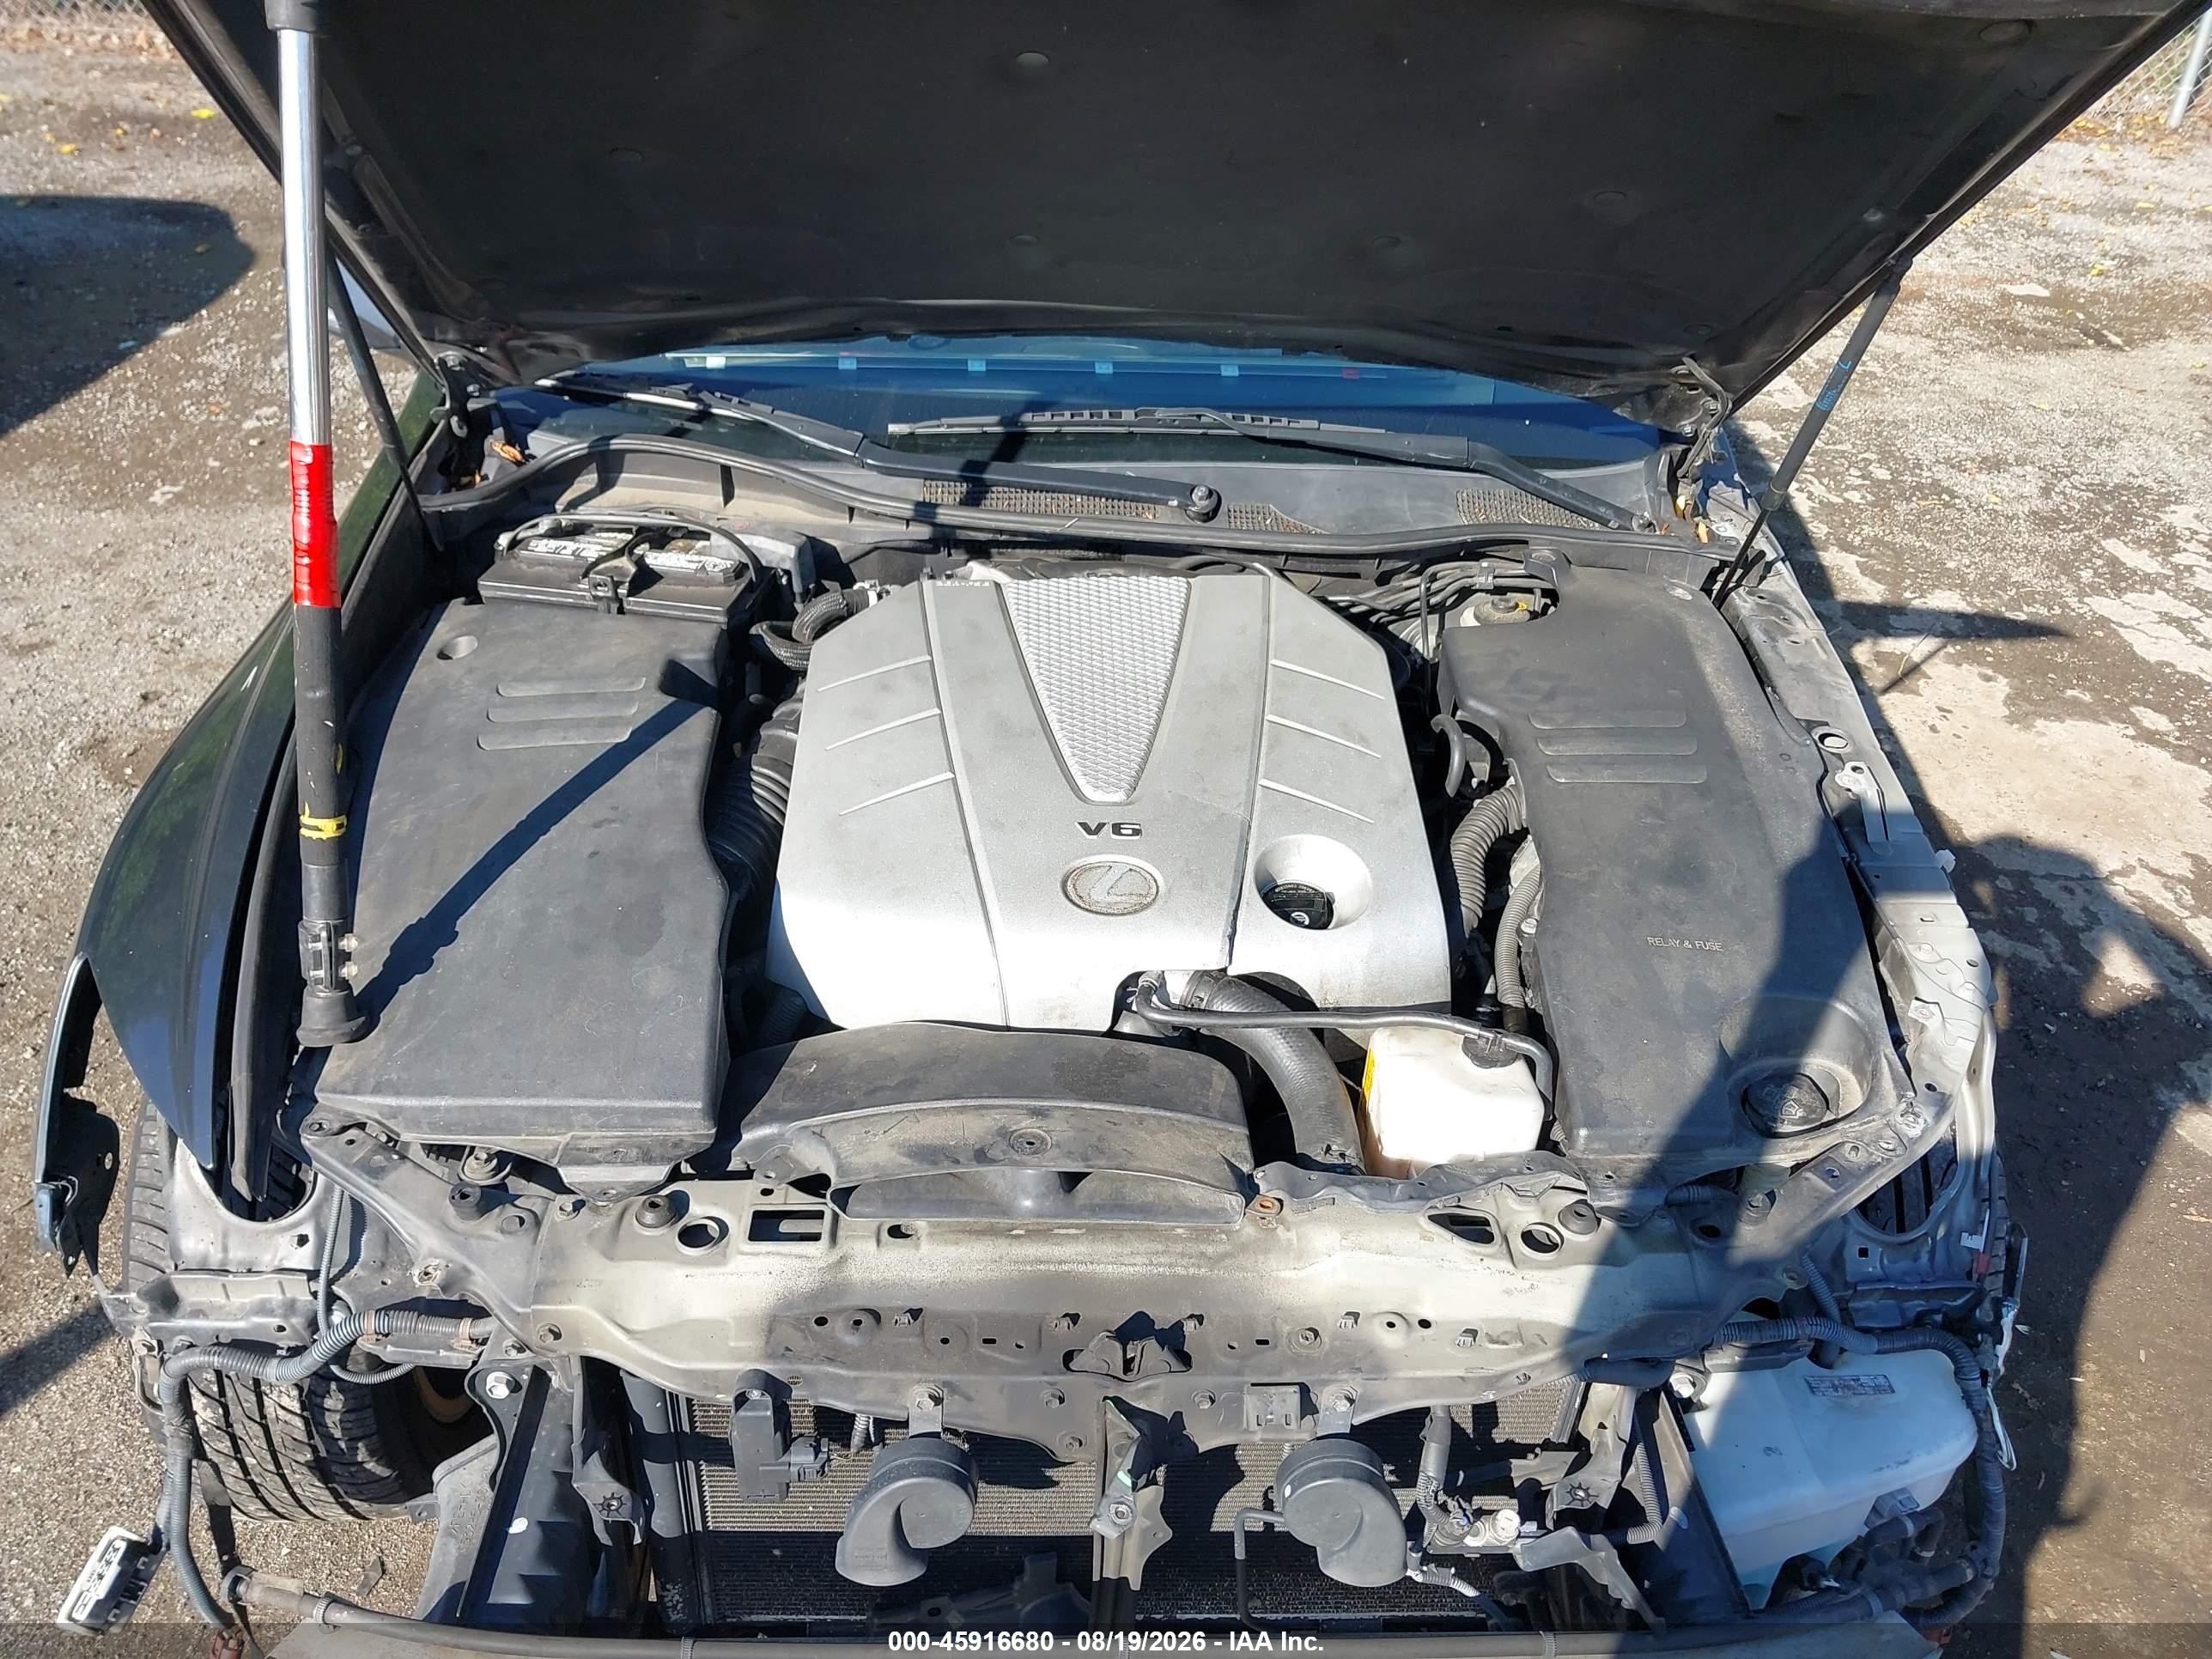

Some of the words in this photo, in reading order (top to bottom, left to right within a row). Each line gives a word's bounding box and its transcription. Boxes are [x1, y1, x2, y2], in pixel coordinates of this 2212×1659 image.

[1076, 822, 1142, 839] V6
[1646, 936, 1680, 949] RELAY
[1683, 939, 1692, 949] &
[1694, 940, 1724, 951] FUSE
